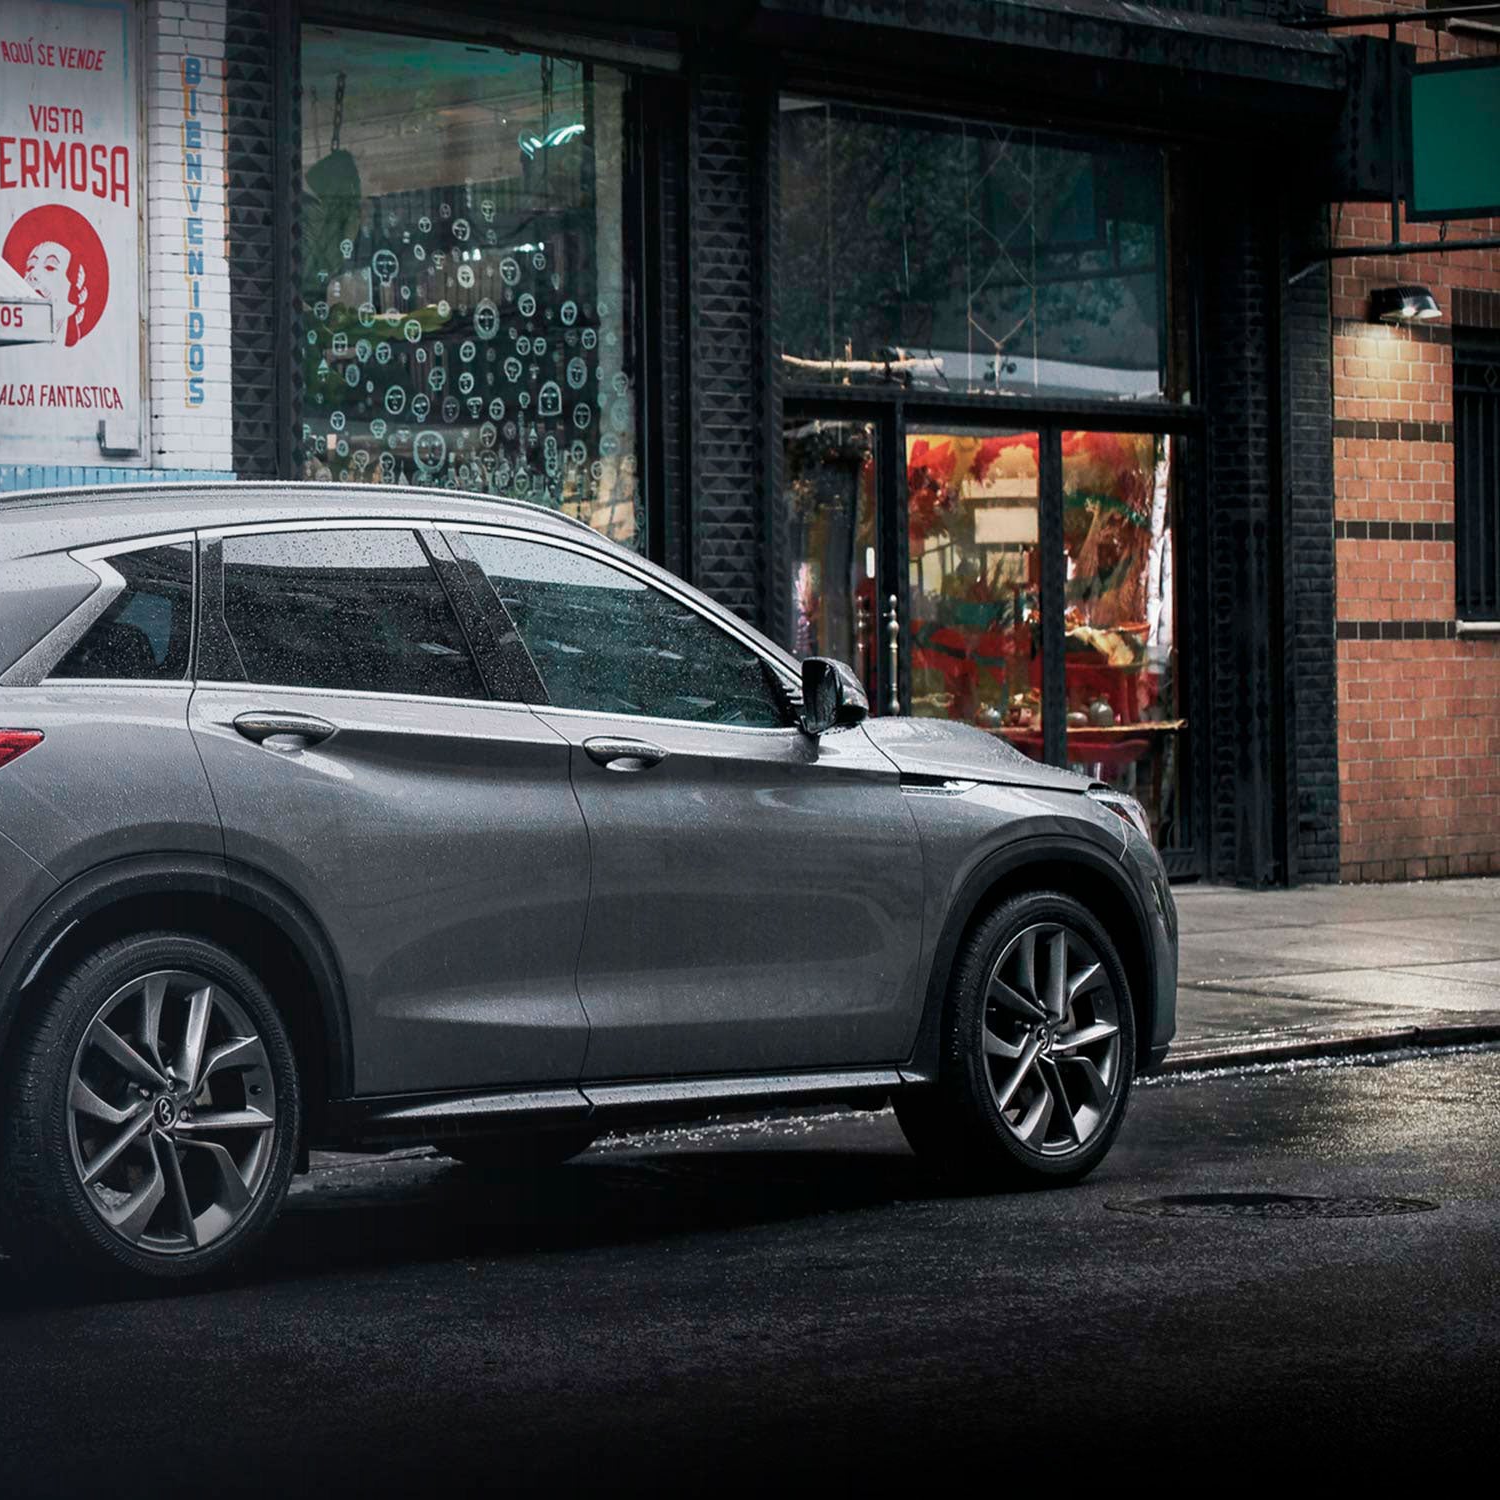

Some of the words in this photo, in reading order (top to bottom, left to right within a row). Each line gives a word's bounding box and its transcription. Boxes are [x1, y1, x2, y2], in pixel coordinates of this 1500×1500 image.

[1, 37, 35, 65] AQUÍ
[38, 43, 55, 67] SE
[59, 47, 106, 71] VENDE
[29, 104, 83, 134] VISTA
[181, 57, 205, 408] BIENVENIDOS
[40, 384, 124, 410] FANTASTICA
